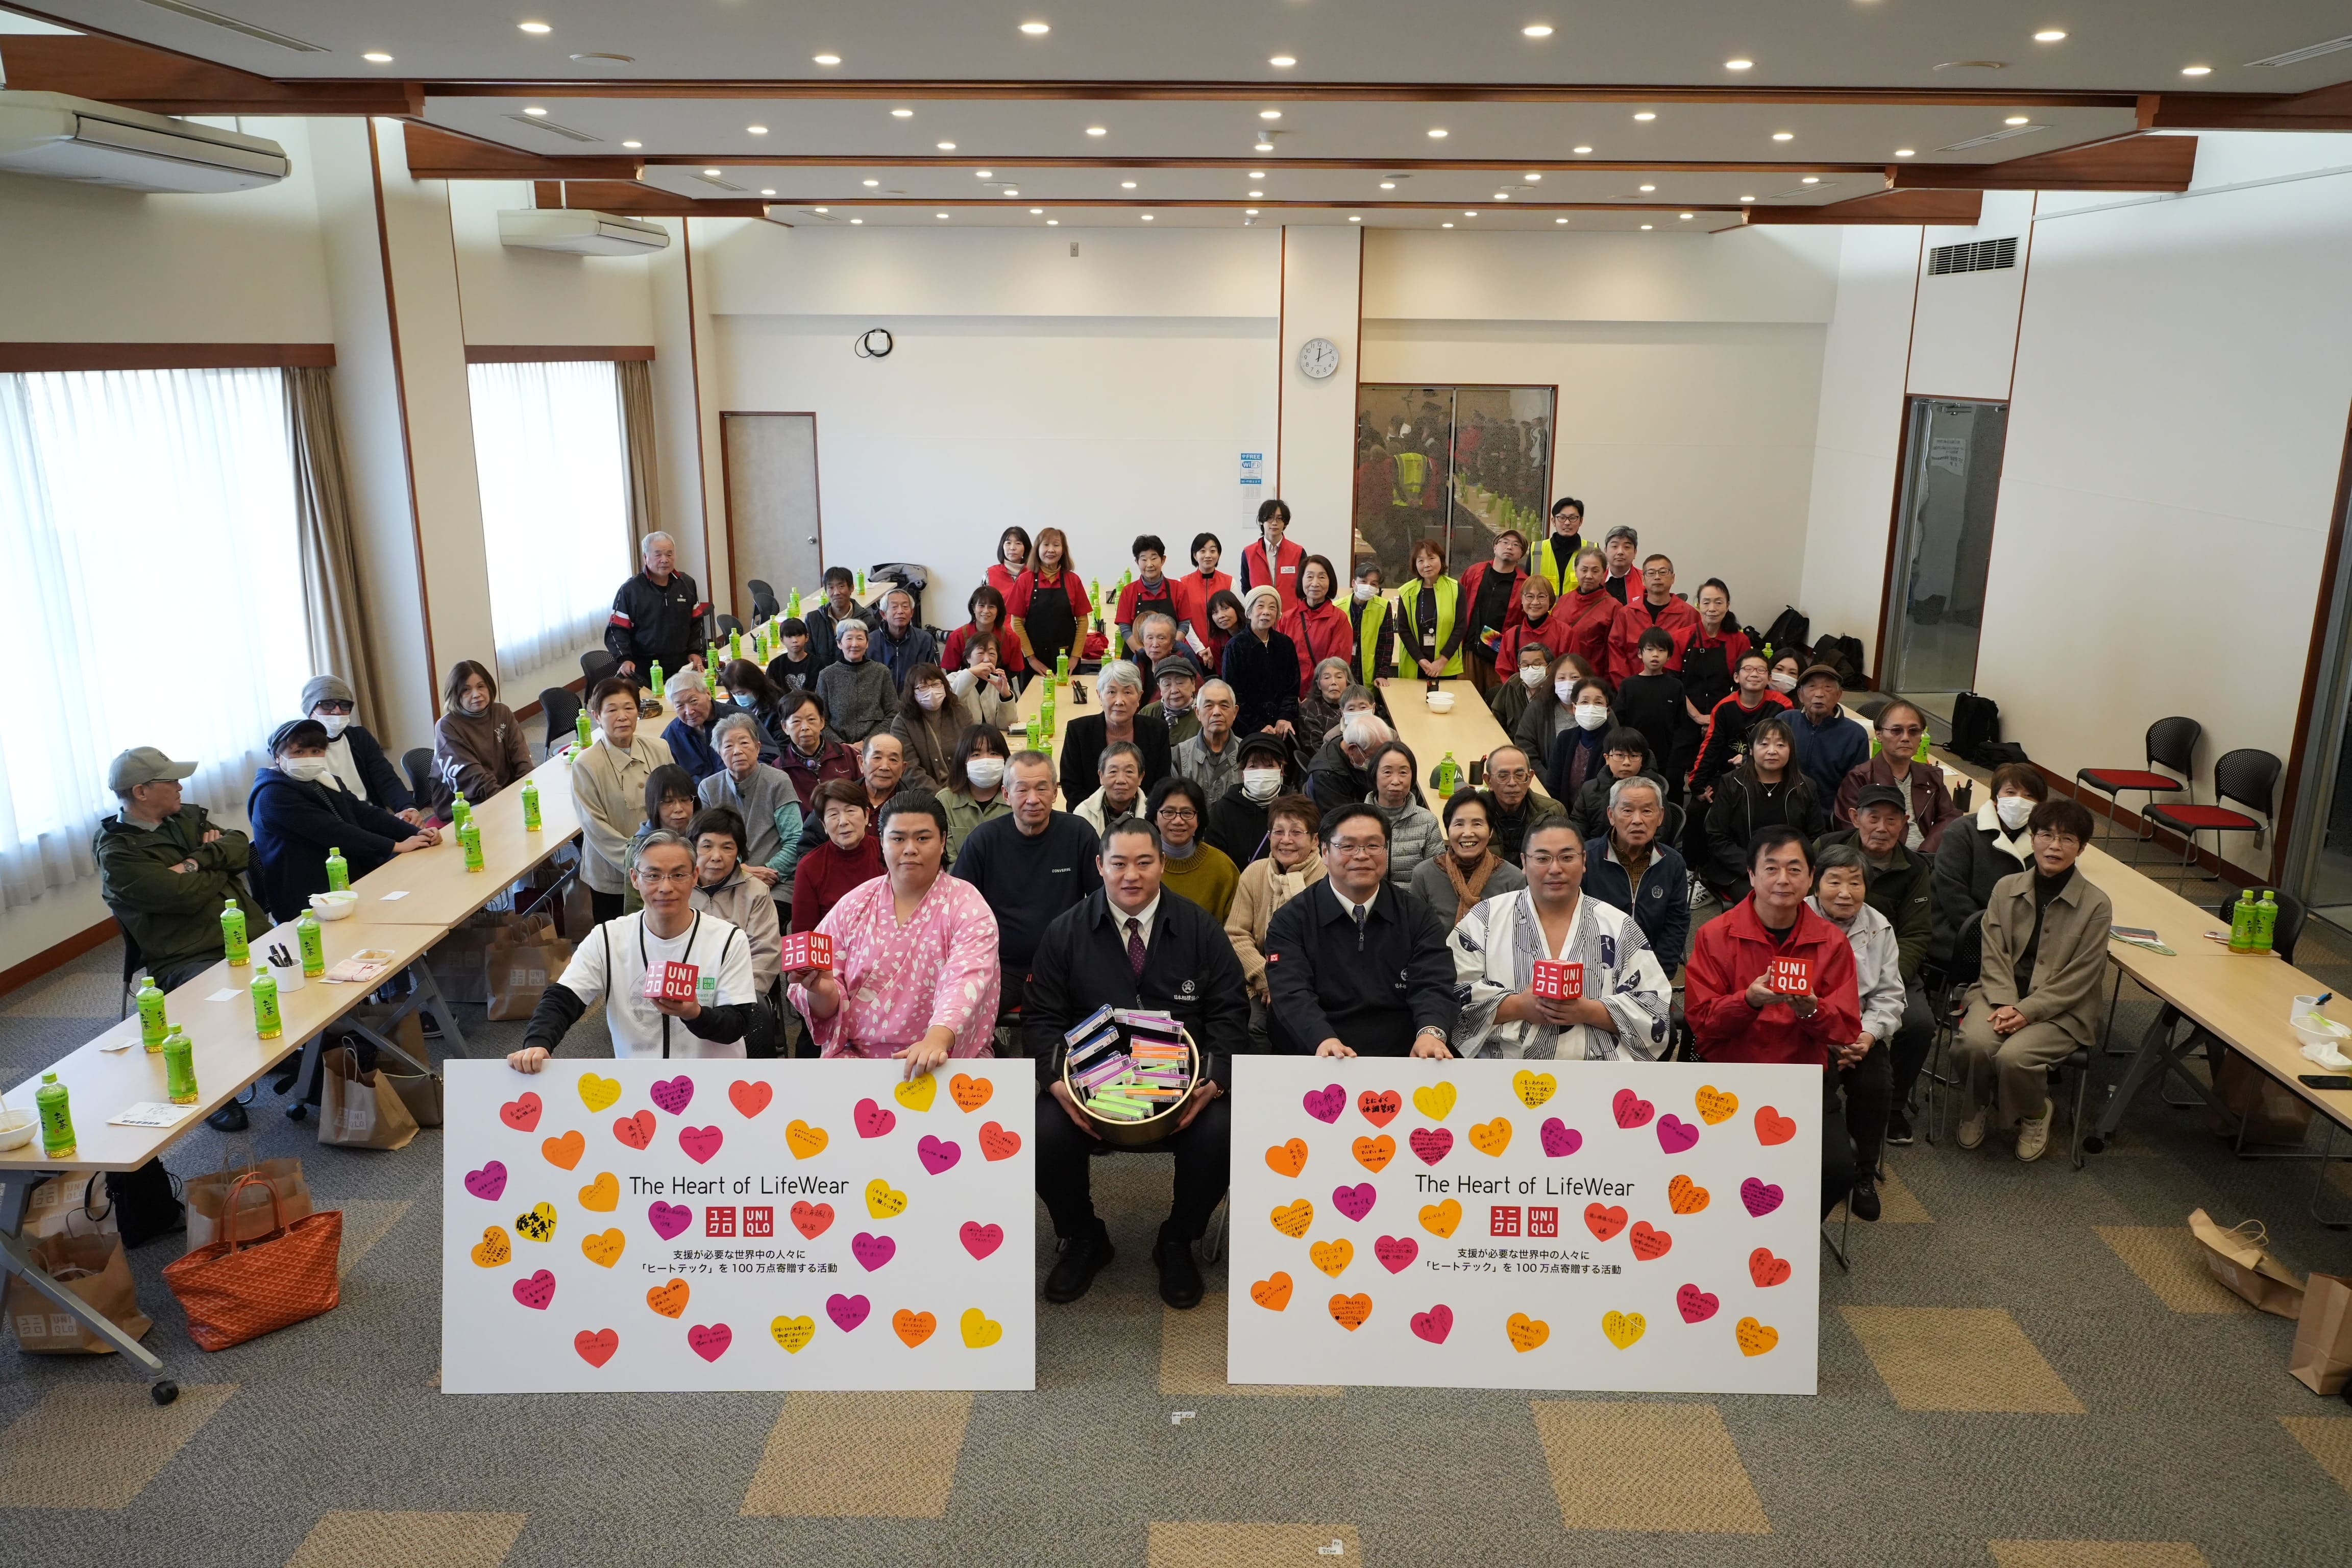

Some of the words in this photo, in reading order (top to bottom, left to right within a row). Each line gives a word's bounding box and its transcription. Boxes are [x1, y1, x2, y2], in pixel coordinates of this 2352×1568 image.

[786, 936, 805, 951] ユニ
[811, 936, 828, 950] UNI
[811, 951, 830, 965] QLO
[668, 966, 693, 982] UNI
[1537, 966, 1557, 980] ユニ
[1563, 969, 1579, 981] UNI
[1779, 962, 1805, 976] UNI
[666, 981, 692, 996] QLO
[1535, 980, 1557, 994] クロ
[1778, 976, 1807, 991] QLO
[1563, 983, 1580, 997] QLO
[630, 1177, 664, 1194] The
[673, 1177, 725, 1194] Heart
[733, 1177, 751, 1194] of
[762, 1176, 849, 1194] LifeWear
[1415, 1175, 1449, 1192] The
[1458, 1176, 1510, 1193] Heart
[1518, 1177, 1536, 1194] of
[1547, 1177, 1635, 1196] LifeWear
[710, 1211, 732, 1220] ユニ
[746, 1211, 768, 1220] UNI
[1495, 1210, 1516, 1220] ユニ
[1532, 1211, 1553, 1221] UNI
[709, 1223, 732, 1233] クロ
[746, 1223, 770, 1235] QLO
[1494, 1222, 1516, 1233] クロ
[1531, 1223, 1554, 1235] QLO
[674, 1250, 805, 1260] 支援が必要な世界中の人々に
[1458, 1248, 1589, 1260] 支援が必要な世界中の人々に
[53, 1316, 71, 1324] UNI
[55, 1325, 74, 1333] QLO
